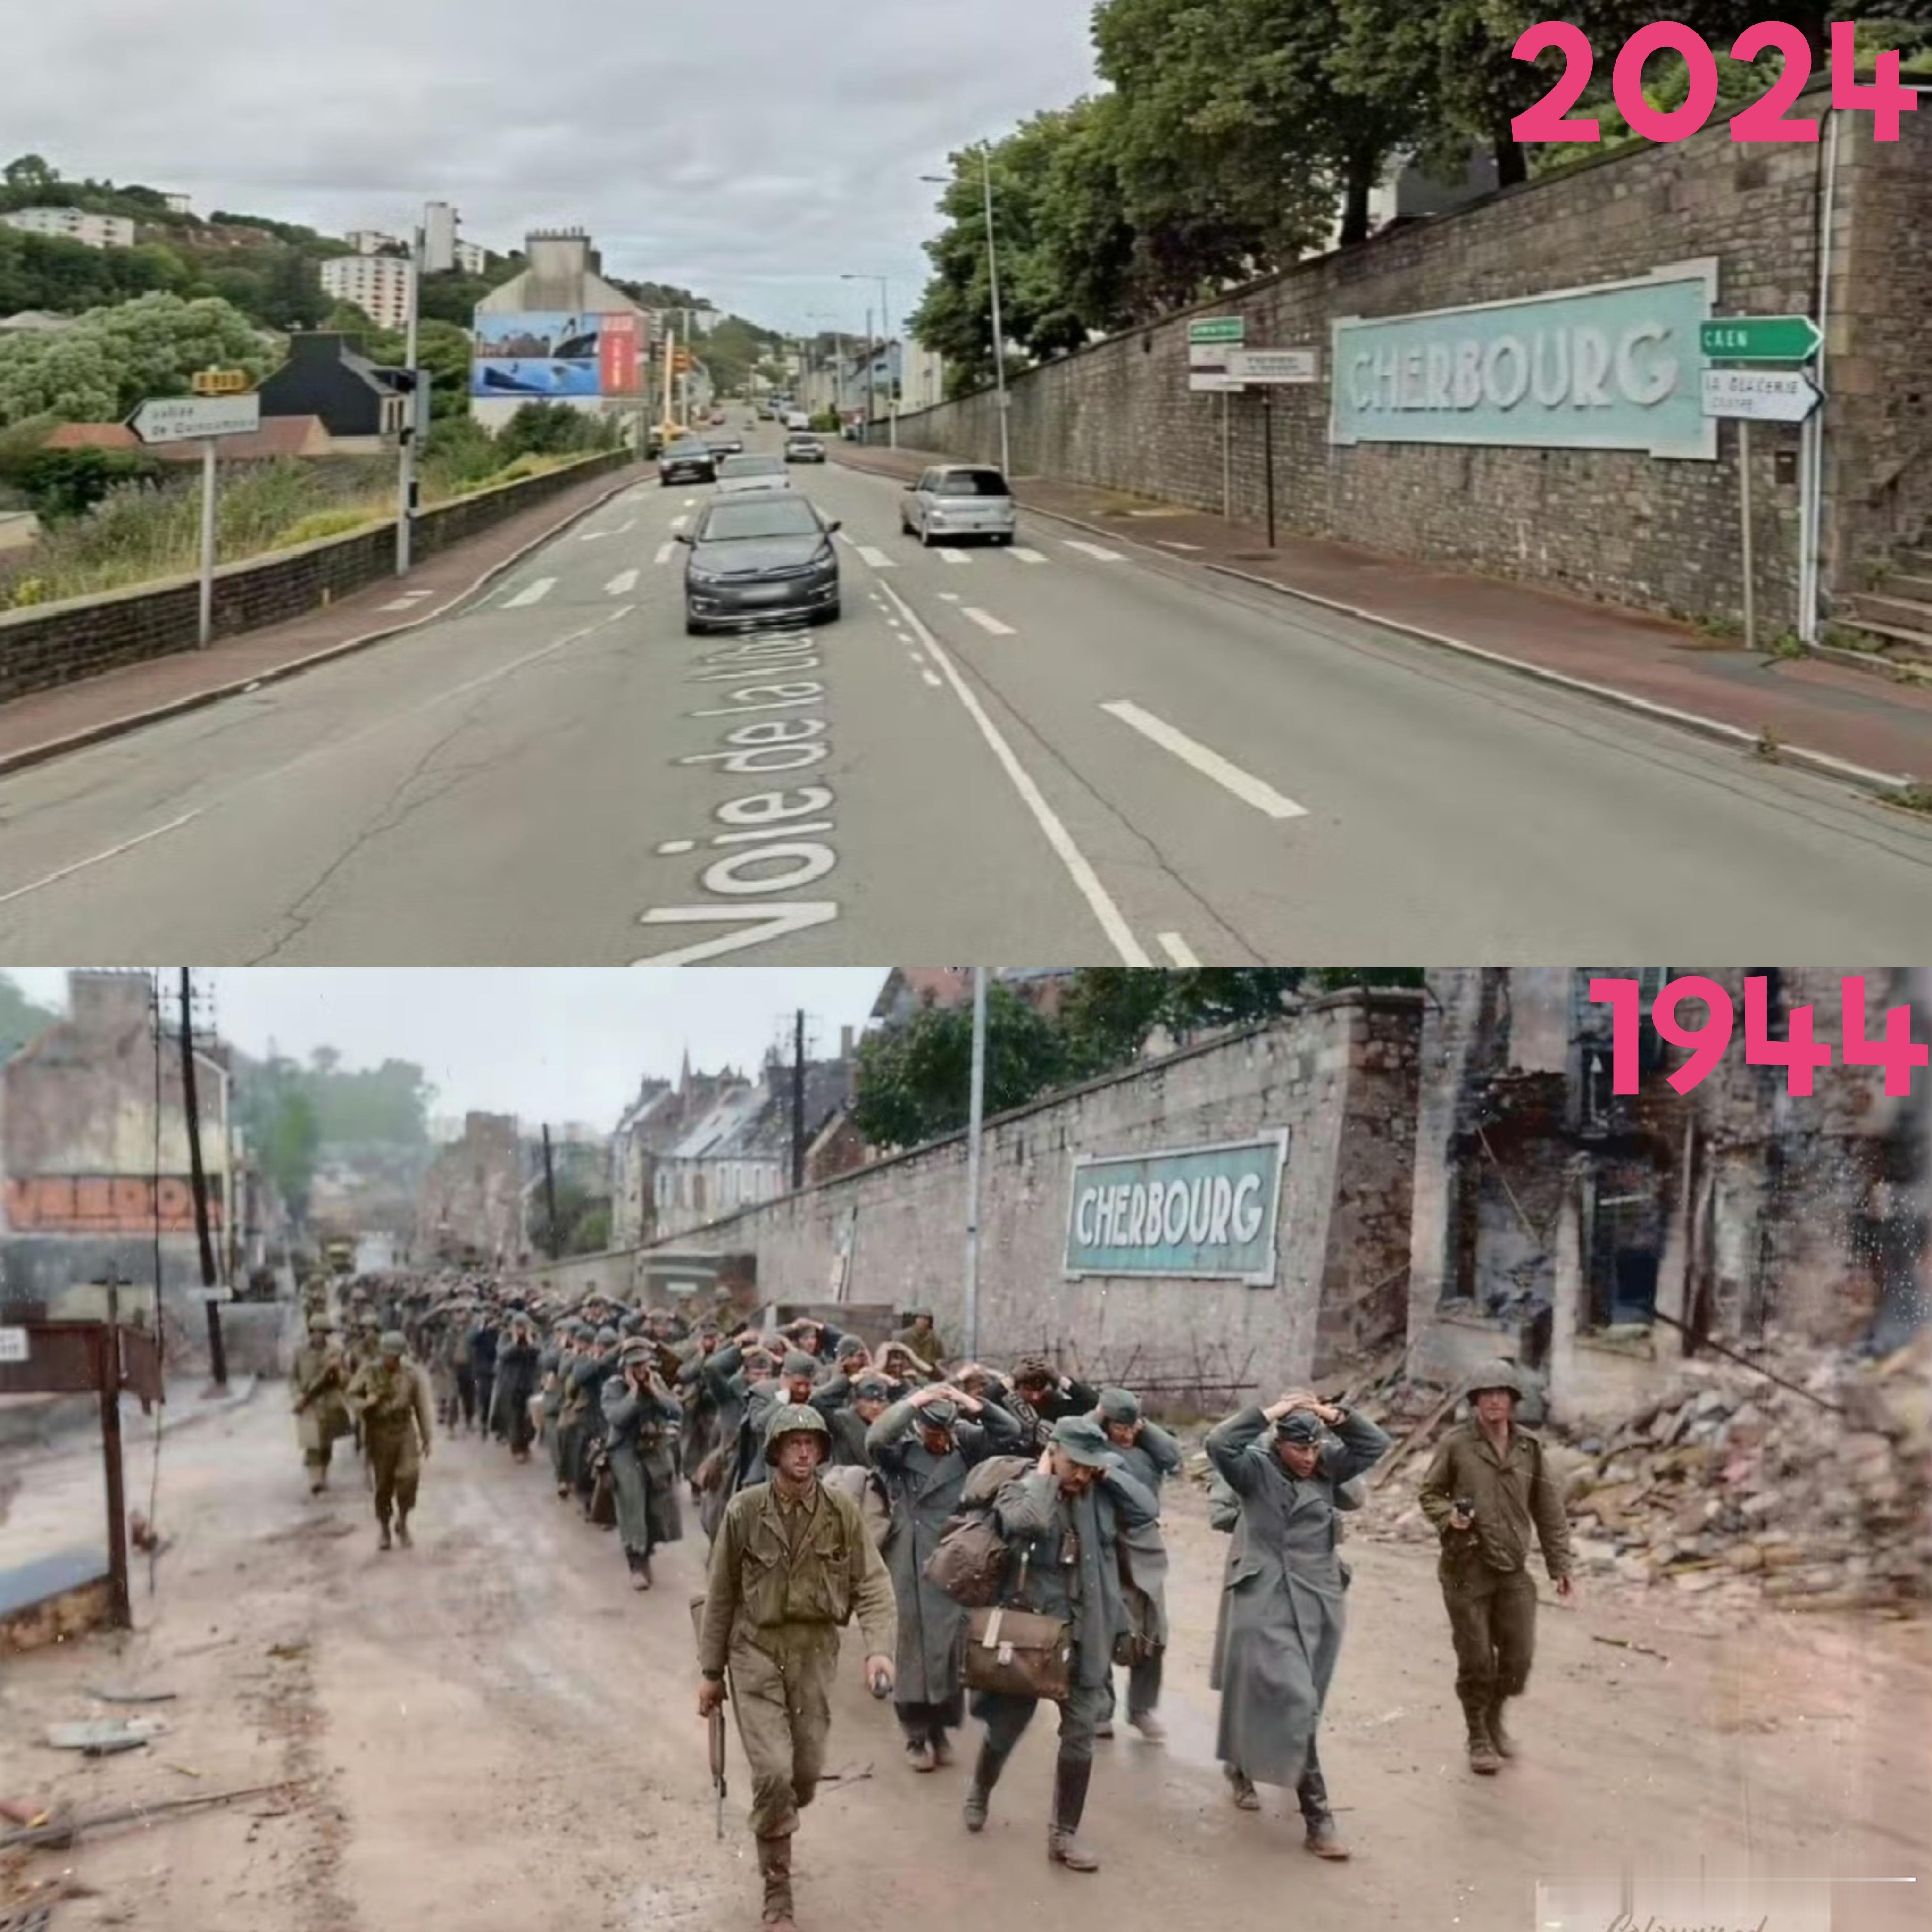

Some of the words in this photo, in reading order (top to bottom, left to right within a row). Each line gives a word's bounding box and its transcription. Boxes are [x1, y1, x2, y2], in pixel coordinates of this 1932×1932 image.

[1348, 321, 1679, 410] CHERBOURG
[1704, 329, 1748, 347] CAEN
[1077, 1173, 1264, 1248] CHERBOURG
